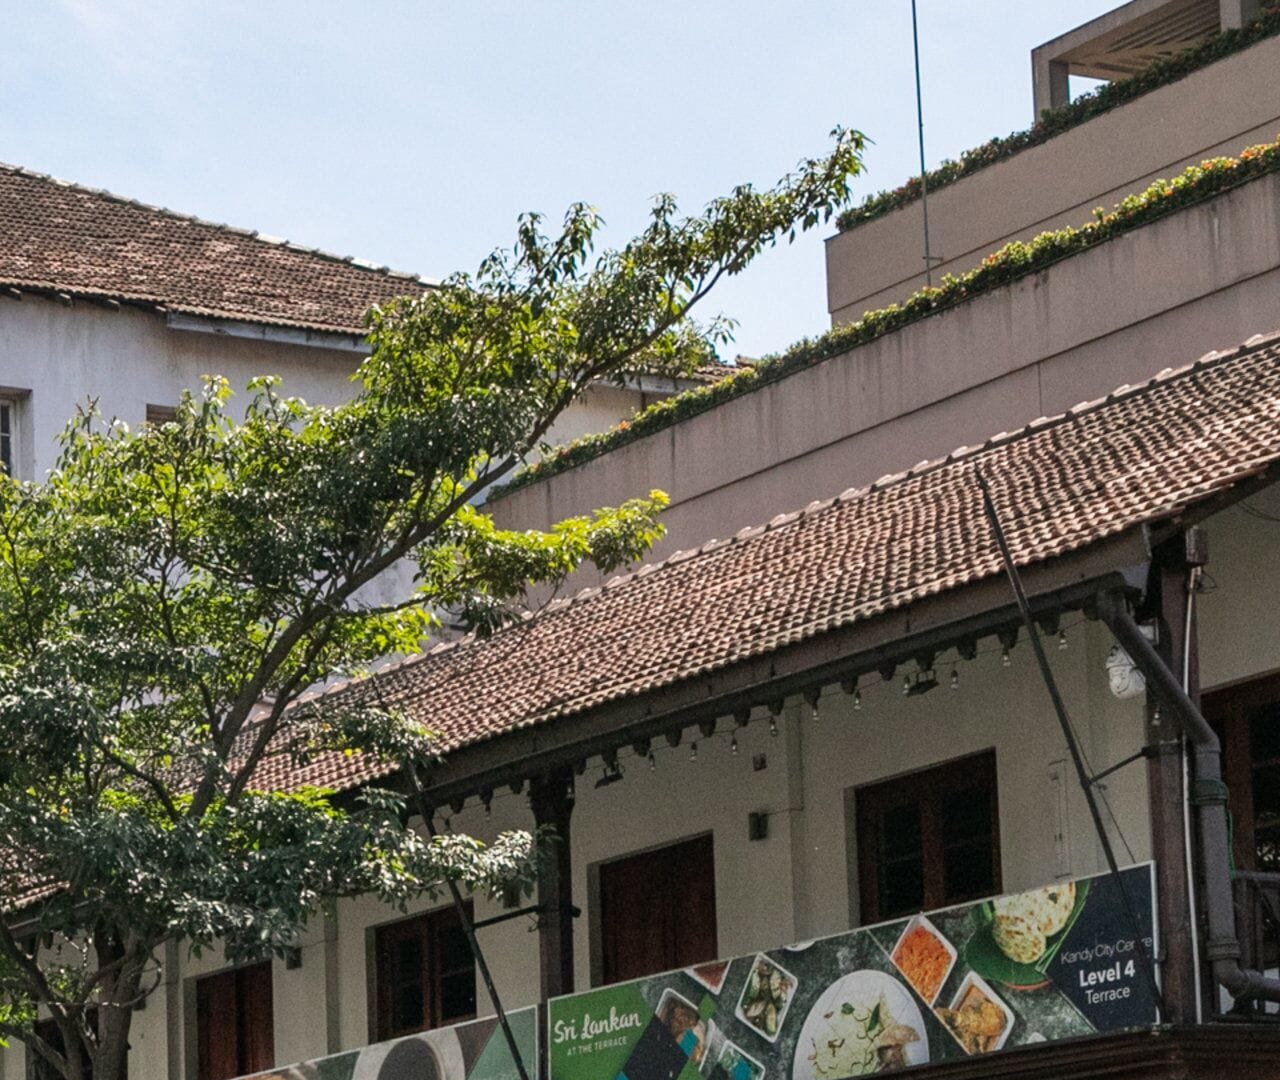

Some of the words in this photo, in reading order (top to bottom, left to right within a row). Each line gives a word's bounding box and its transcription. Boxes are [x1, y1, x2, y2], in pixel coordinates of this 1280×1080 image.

[1095, 944, 1114, 957] City
[1080, 961, 1120, 987] Level
[1124, 959, 1135, 977] 4
[1085, 986, 1130, 1004] Terrace
[553, 1019, 578, 1043] Sri
[581, 1006, 642, 1039] Lankan
[578, 1043, 592, 1053] THE
[594, 1036, 628, 1050] TERRACE
